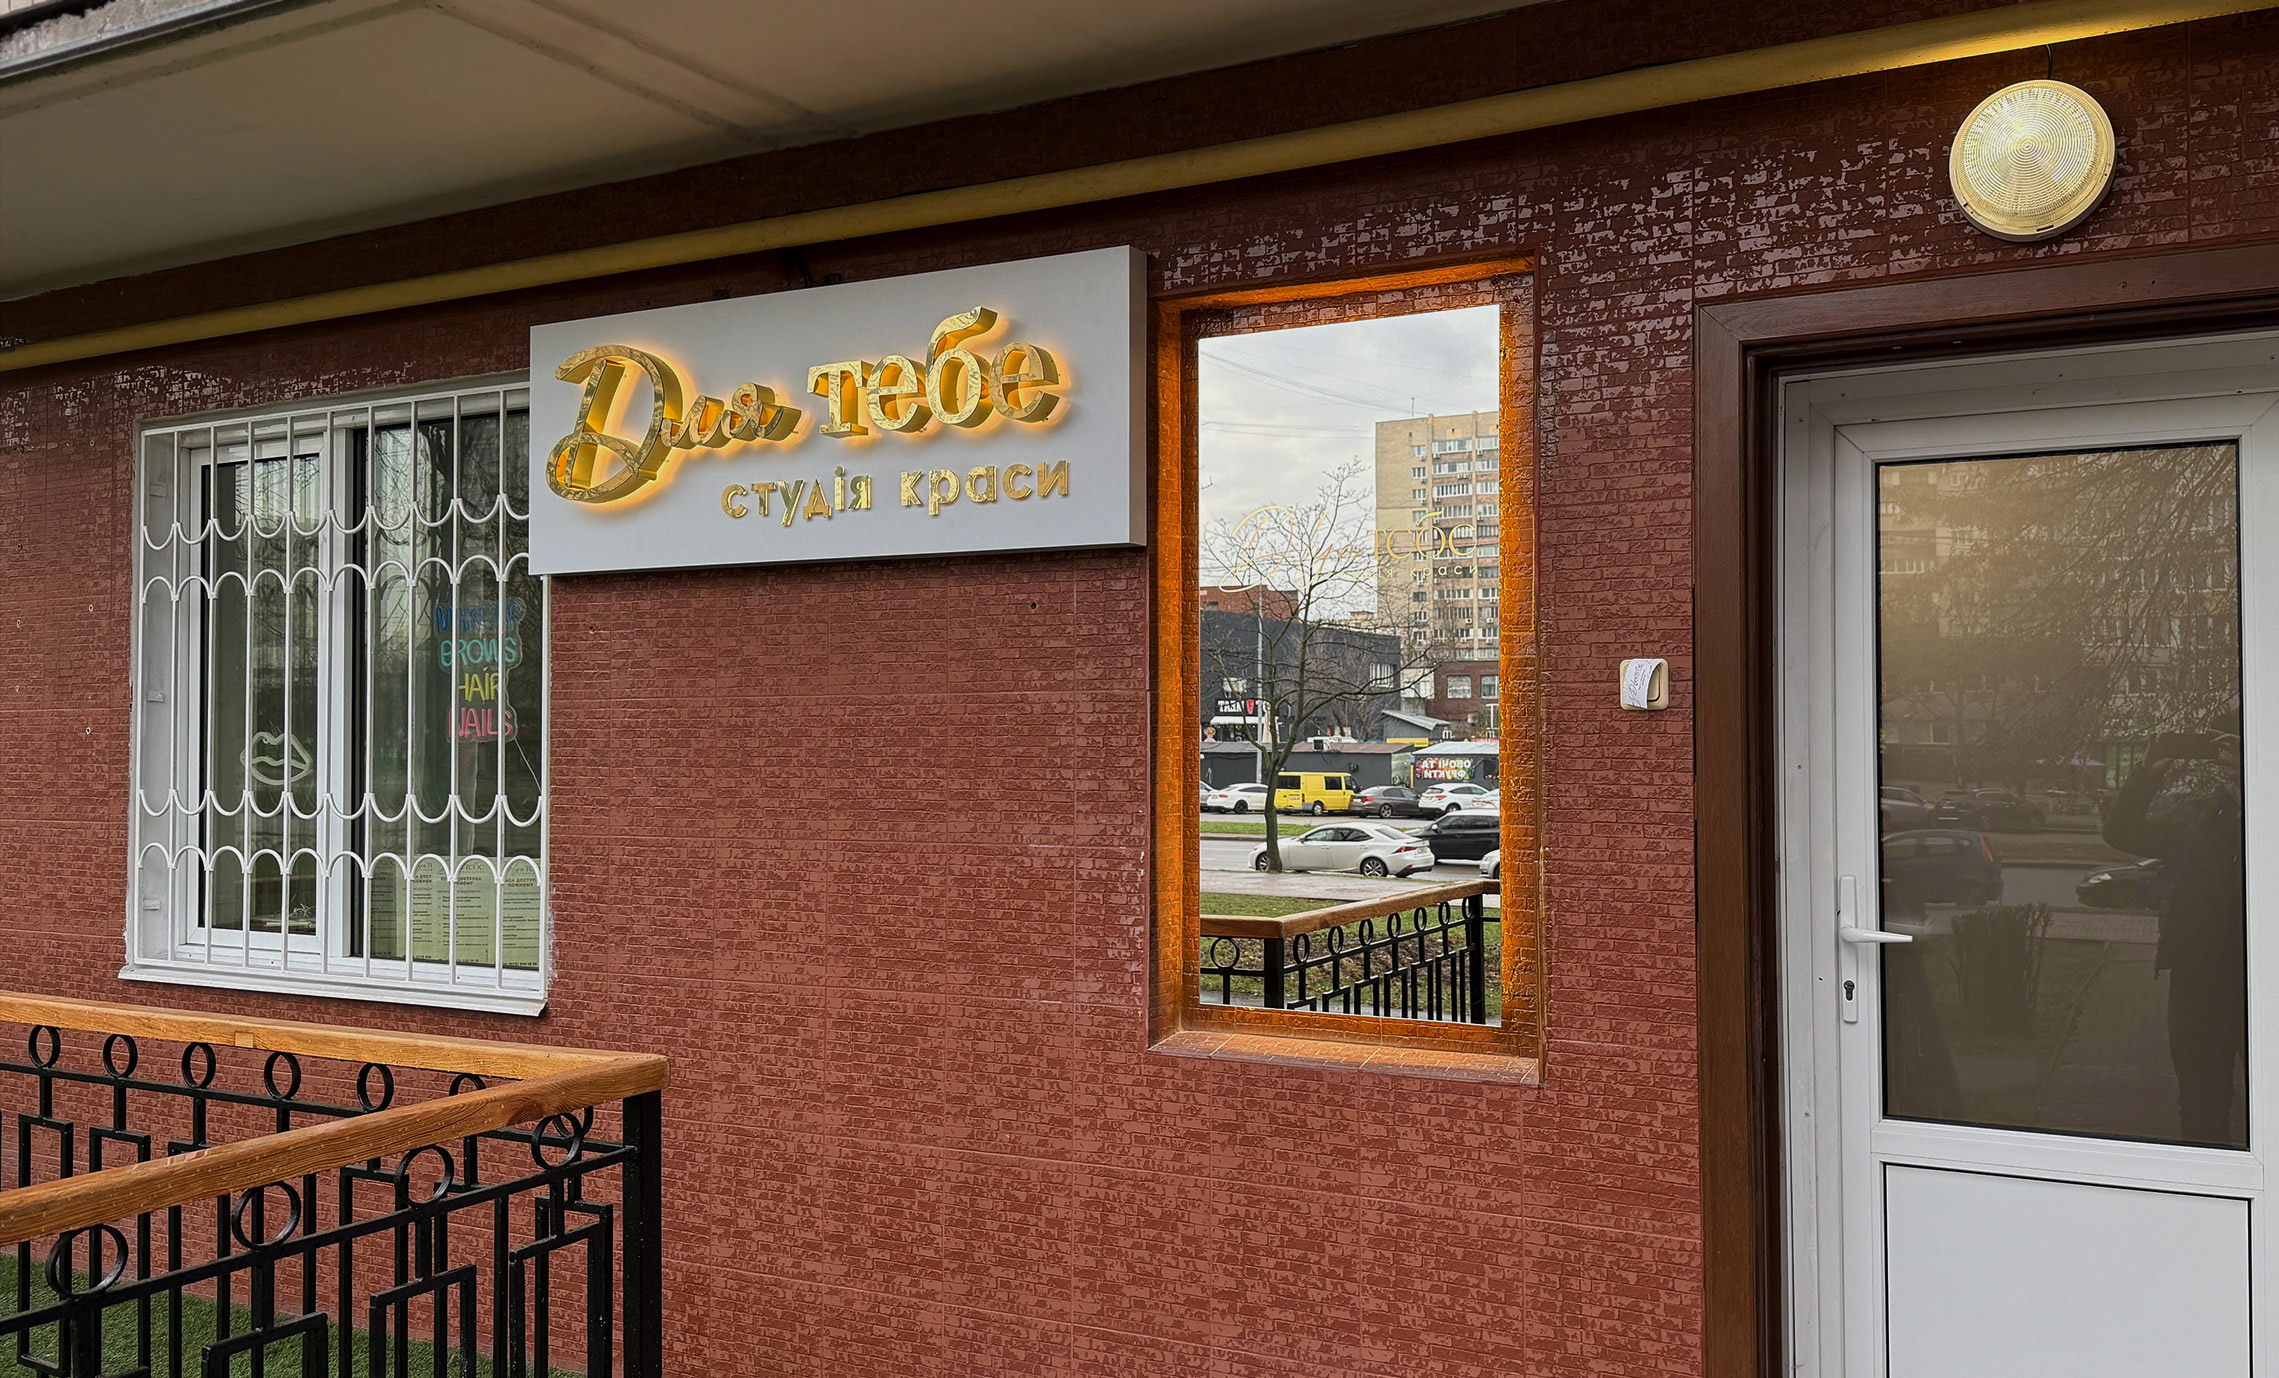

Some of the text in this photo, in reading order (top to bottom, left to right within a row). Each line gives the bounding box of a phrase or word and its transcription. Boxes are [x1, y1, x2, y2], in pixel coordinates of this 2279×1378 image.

[546, 306, 1060, 503] Для тебе
[721, 460, 1069, 526] студія краси
[441, 636, 518, 668] BROWS
